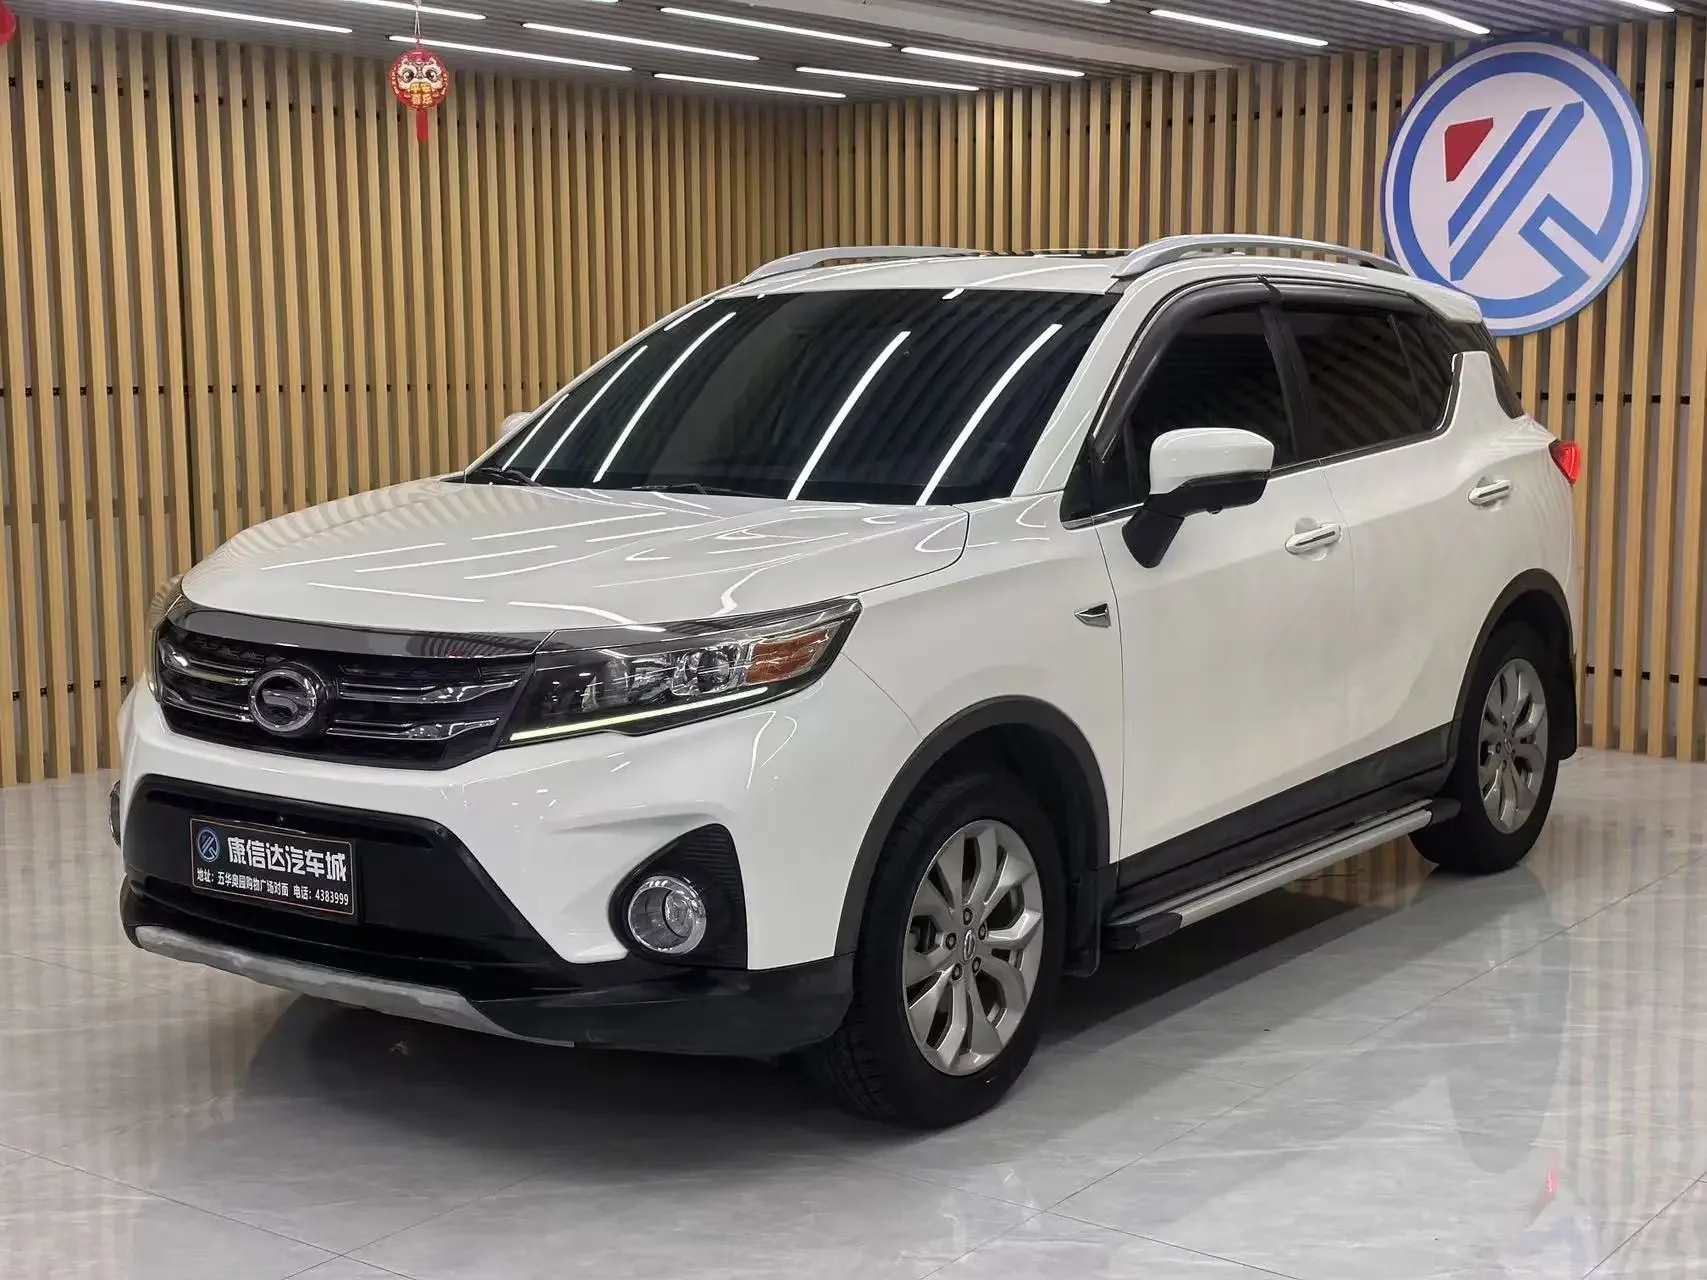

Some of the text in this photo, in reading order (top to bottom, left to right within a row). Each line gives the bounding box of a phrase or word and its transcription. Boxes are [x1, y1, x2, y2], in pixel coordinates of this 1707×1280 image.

[227, 836, 347, 882] 康信达汽车城
